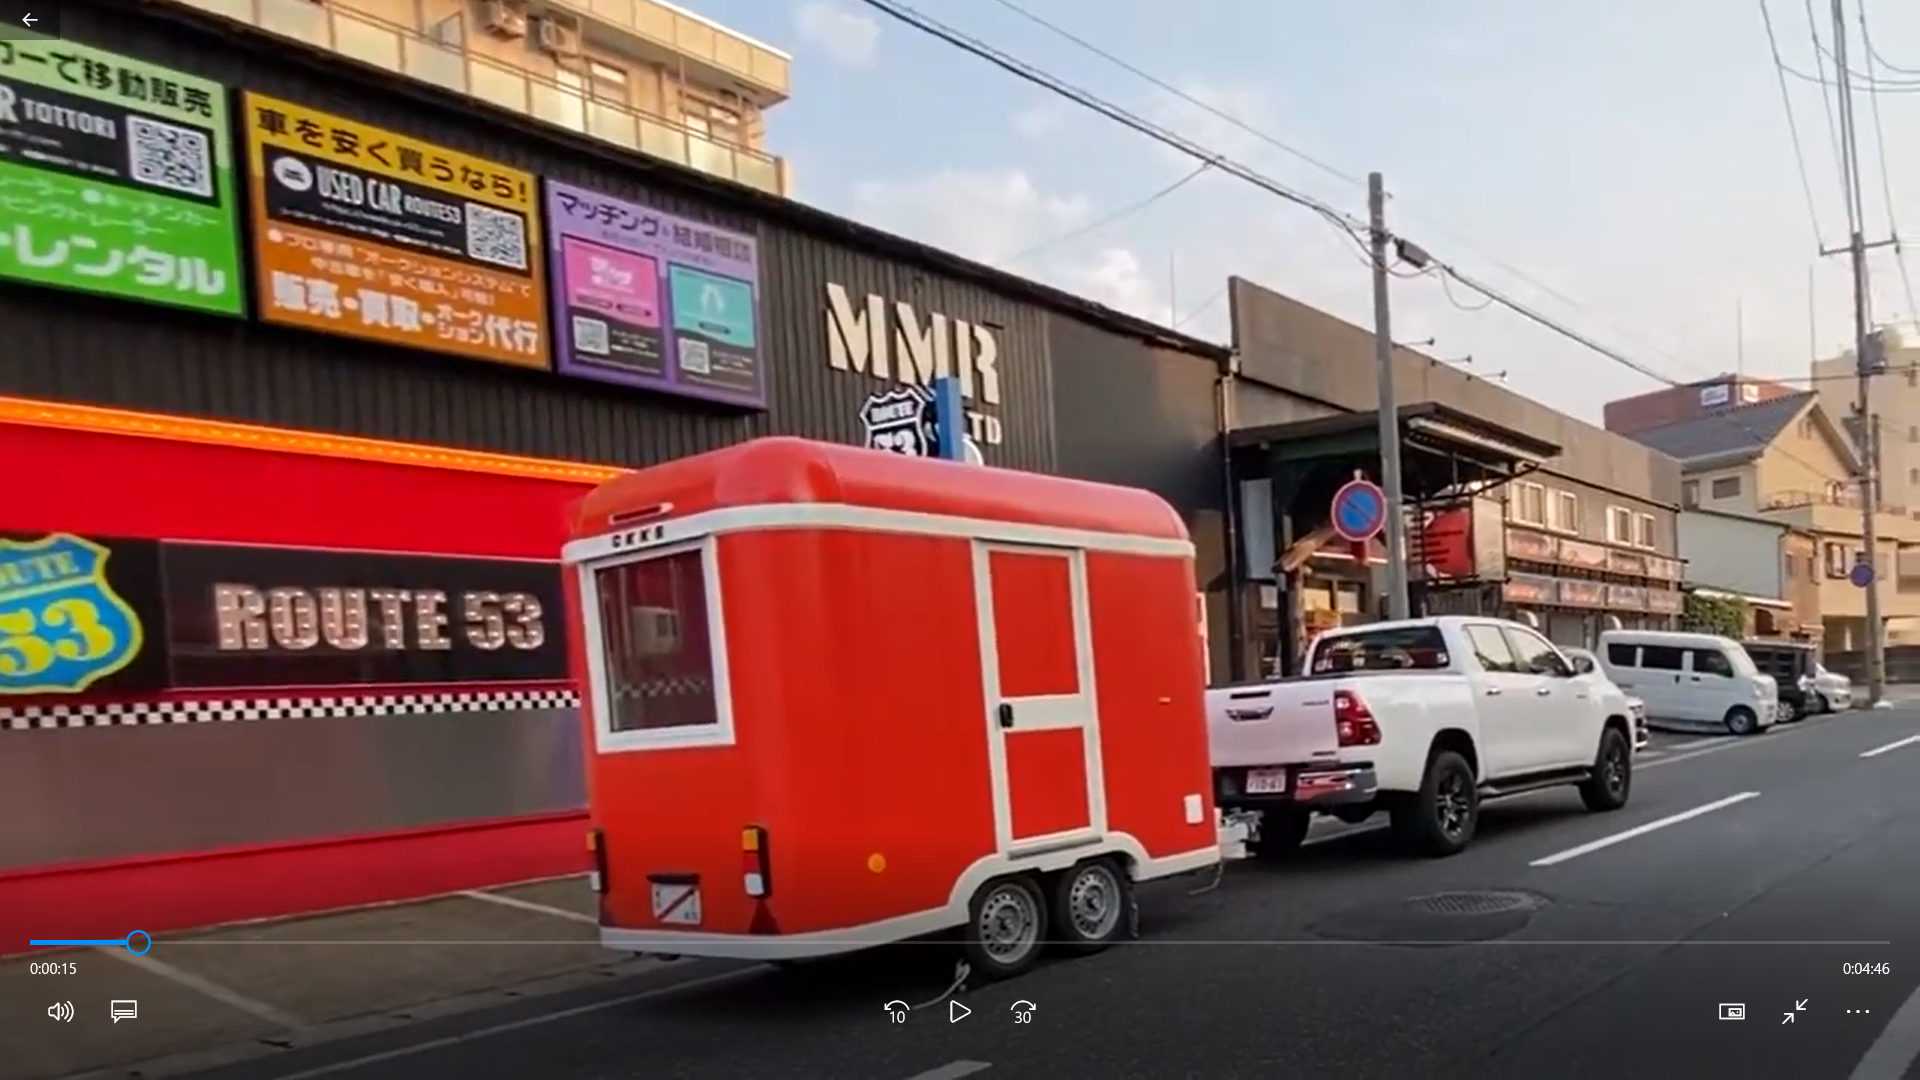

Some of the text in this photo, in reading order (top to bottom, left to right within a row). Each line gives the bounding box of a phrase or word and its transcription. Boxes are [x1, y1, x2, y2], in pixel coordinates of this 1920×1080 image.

[21, 97, 117, 140] TOTTORI
[316, 165, 364, 205] USED
[367, 178, 402, 215] CAR
[826, 281, 1000, 405] MMR
[213, 582, 546, 652] ROUTE 53
